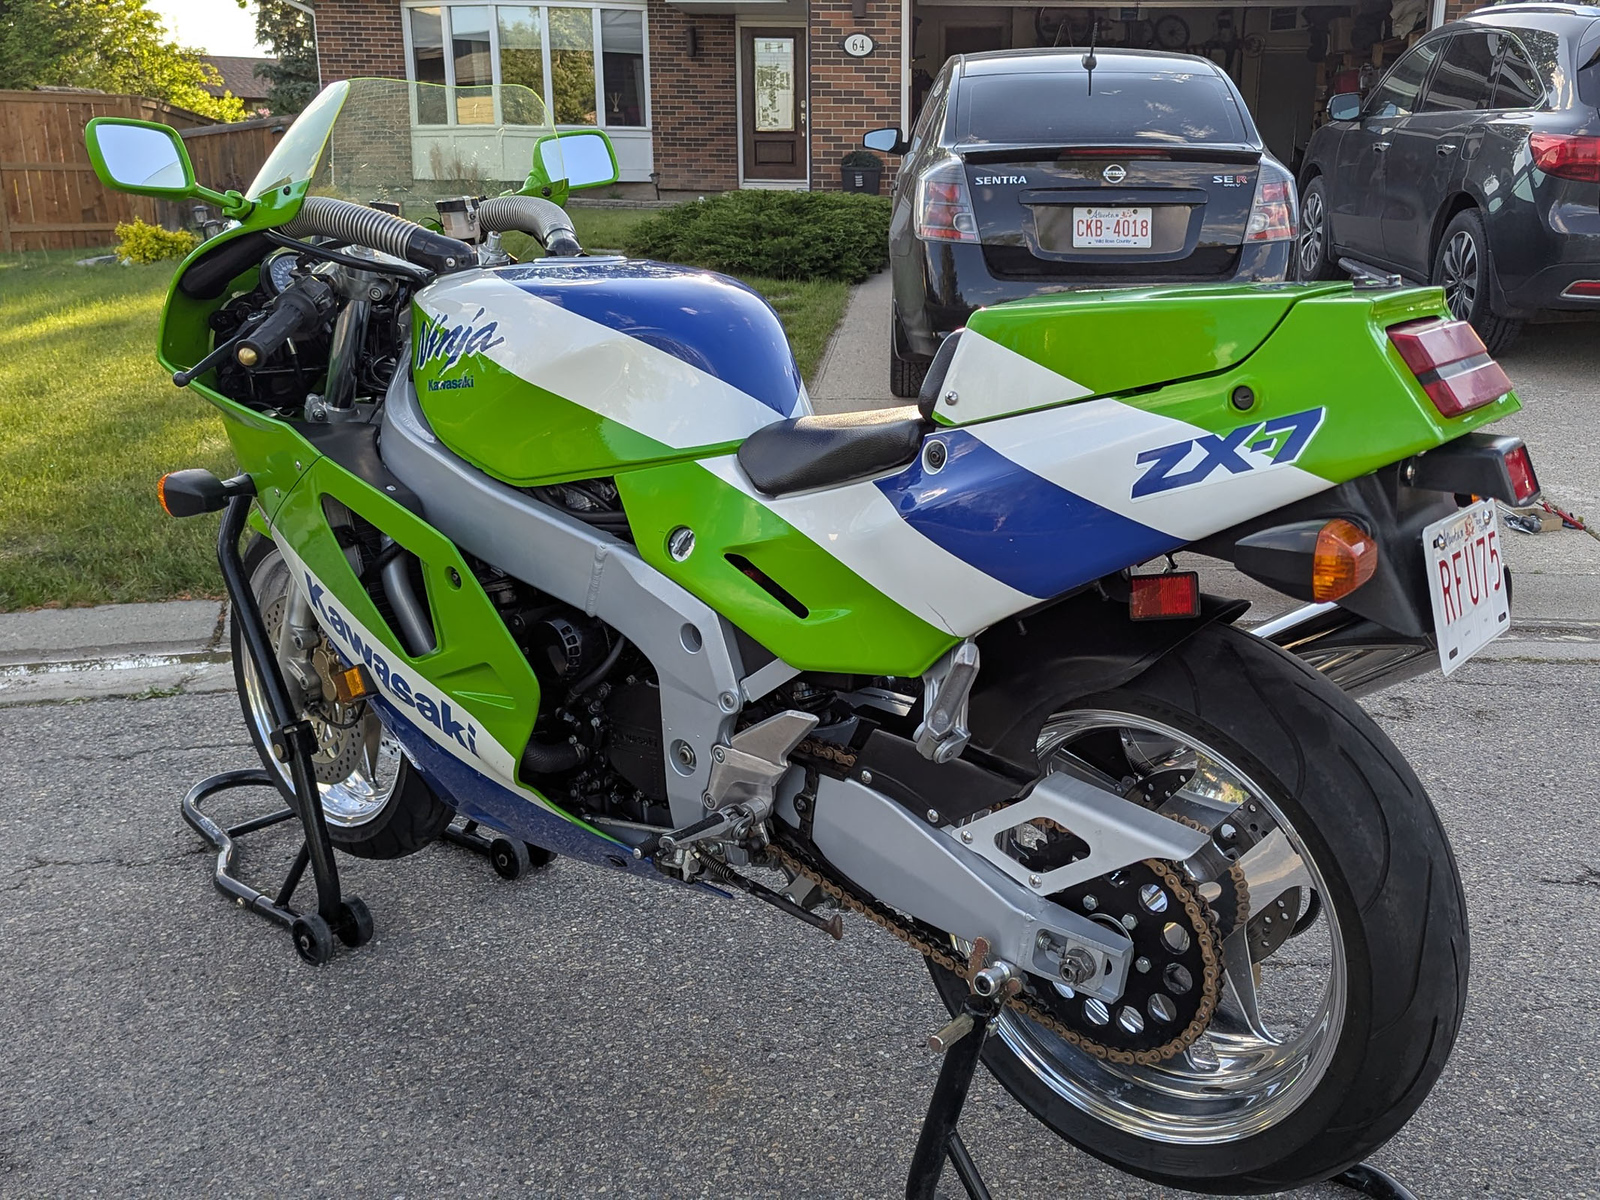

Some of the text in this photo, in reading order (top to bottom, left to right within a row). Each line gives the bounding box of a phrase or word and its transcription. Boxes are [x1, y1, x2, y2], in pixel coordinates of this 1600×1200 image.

[852, 39, 865, 51] 64
[975, 175, 1027, 185] SENTRA
[1090, 209, 1116, 219] Alberta
[1076, 219, 1149, 237] CKB-4018
[415, 307, 505, 376] Ninja
[428, 375, 475, 392] Kawasaki
[1130, 405, 1326, 501] ZX-7
[1438, 530, 1501, 626] RFU75
[304, 570, 482, 760] Kawasaki
